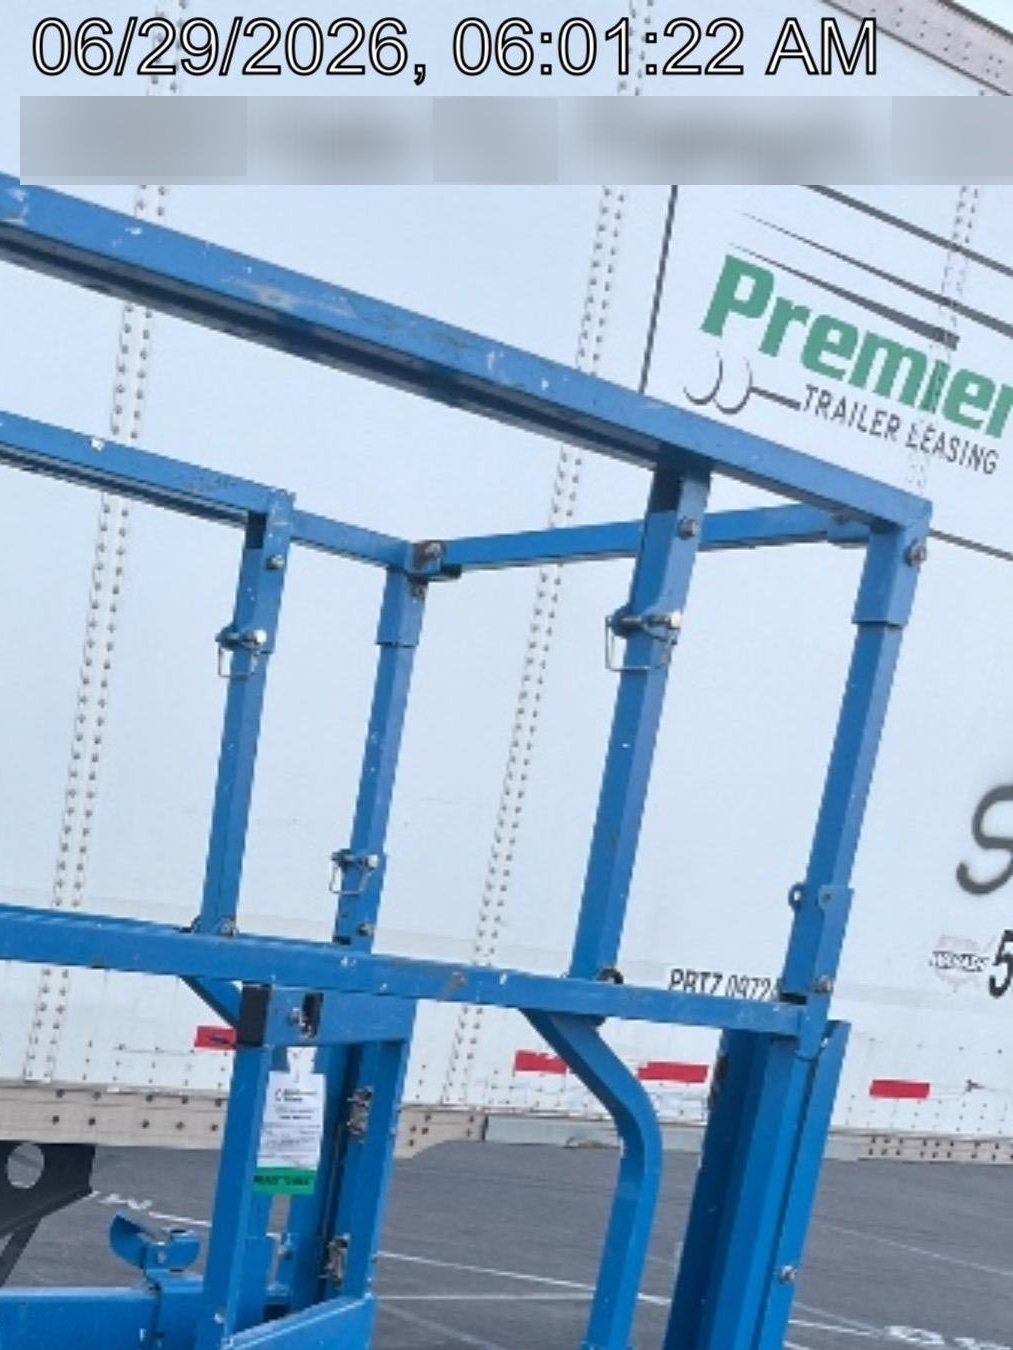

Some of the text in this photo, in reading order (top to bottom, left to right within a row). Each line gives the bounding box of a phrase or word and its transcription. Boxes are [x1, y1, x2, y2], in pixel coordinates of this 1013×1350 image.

[699, 253, 1013, 439] Premier
[802, 383, 1000, 476] TRAILER LEASING
